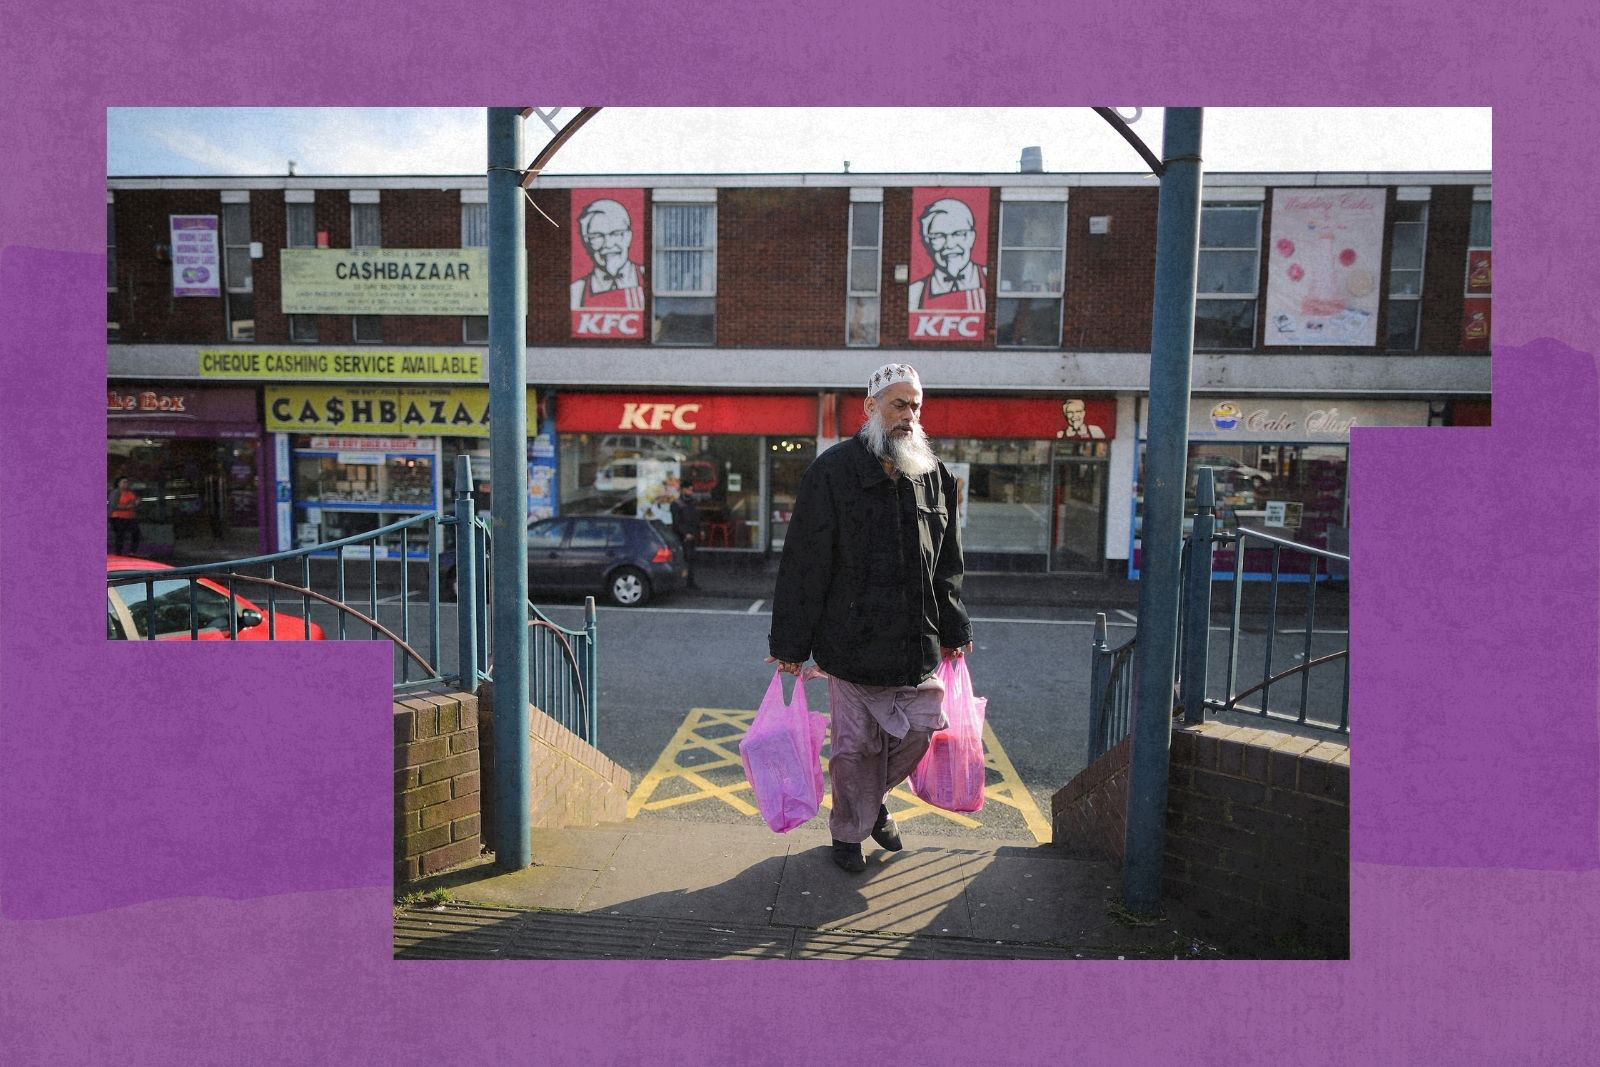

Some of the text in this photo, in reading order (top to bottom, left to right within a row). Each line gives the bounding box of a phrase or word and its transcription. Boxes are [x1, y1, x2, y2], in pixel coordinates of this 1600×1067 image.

[576, 313, 640, 335] KFC
[914, 315, 980, 337] KFC
[203, 354, 479, 375] CHEQUE CASHING SERVICE AVAILABLE
[139, 391, 185, 412] Box
[272, 395, 490, 425] CA$HBAZA
[618, 403, 701, 431] KFC
[1247, 409, 1297, 432] Cake
